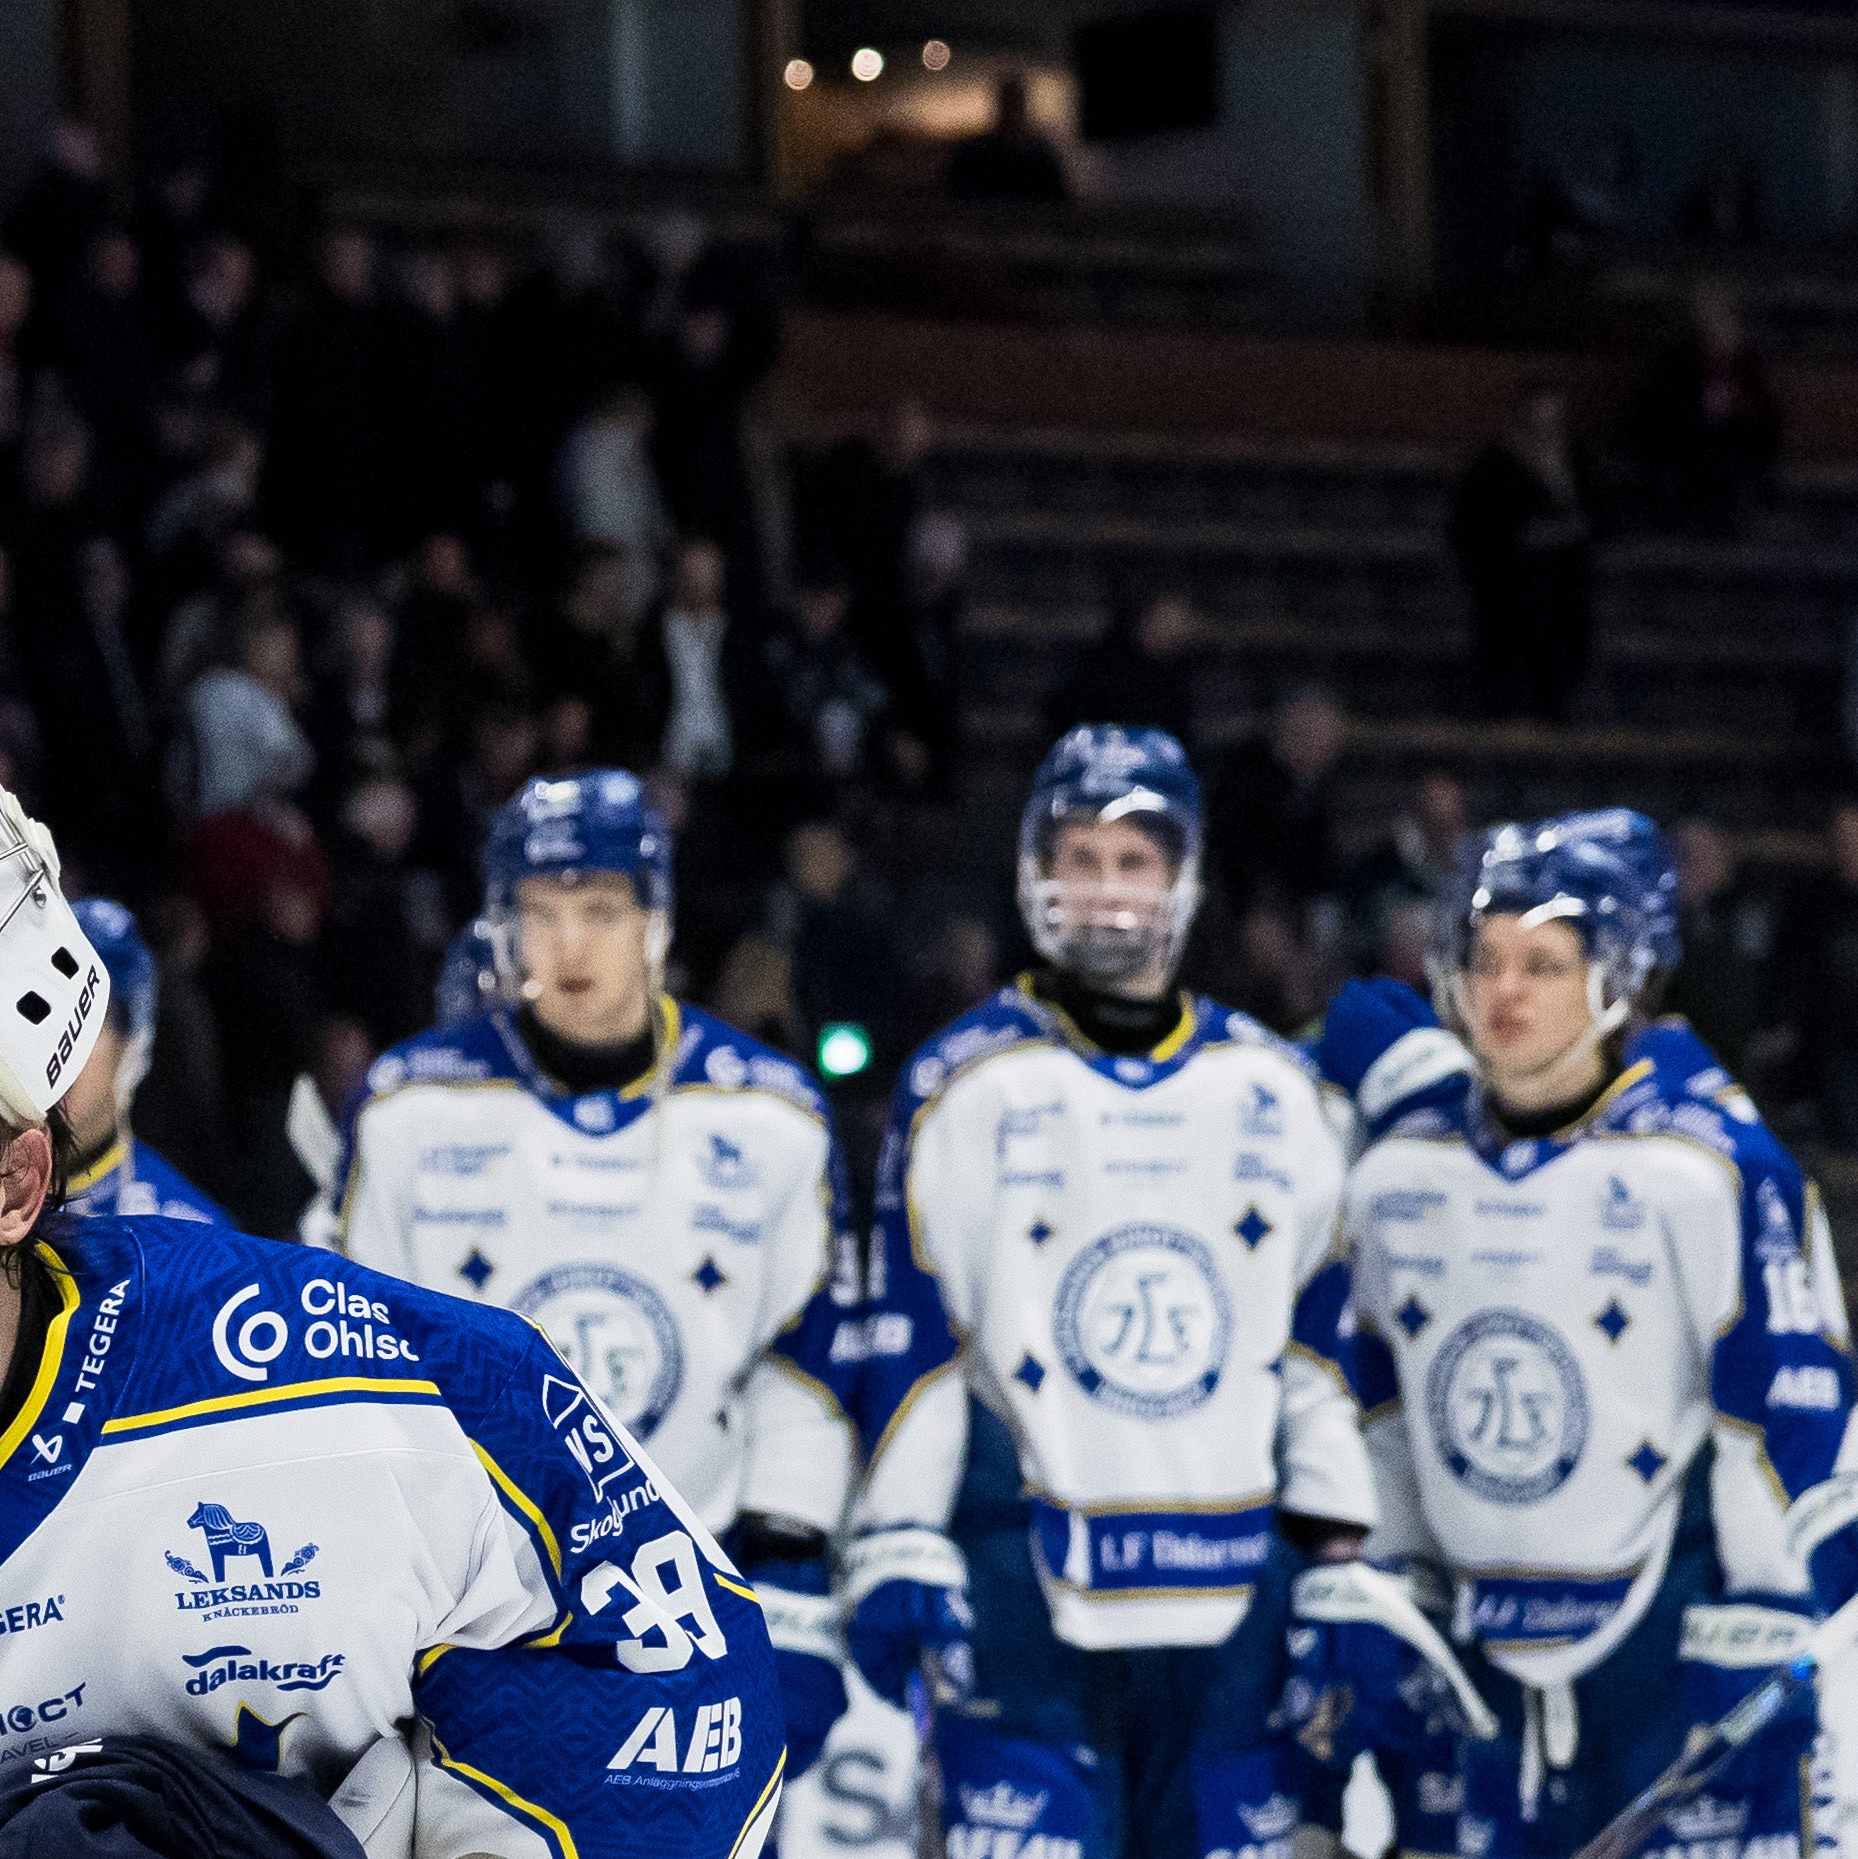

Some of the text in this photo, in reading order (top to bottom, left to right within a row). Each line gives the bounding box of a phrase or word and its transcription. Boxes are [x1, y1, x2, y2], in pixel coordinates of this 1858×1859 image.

[74, 1278, 132, 1393] TEGERA
[300, 1278, 391, 1325] Clas
[570, 1477, 664, 1554] Skogun
[174, 1580, 322, 1611] LEKSANDS
[580, 1529, 728, 1674] 39
[184, 1653, 348, 1697] dalakraft
[605, 1696, 743, 1773] AEB
